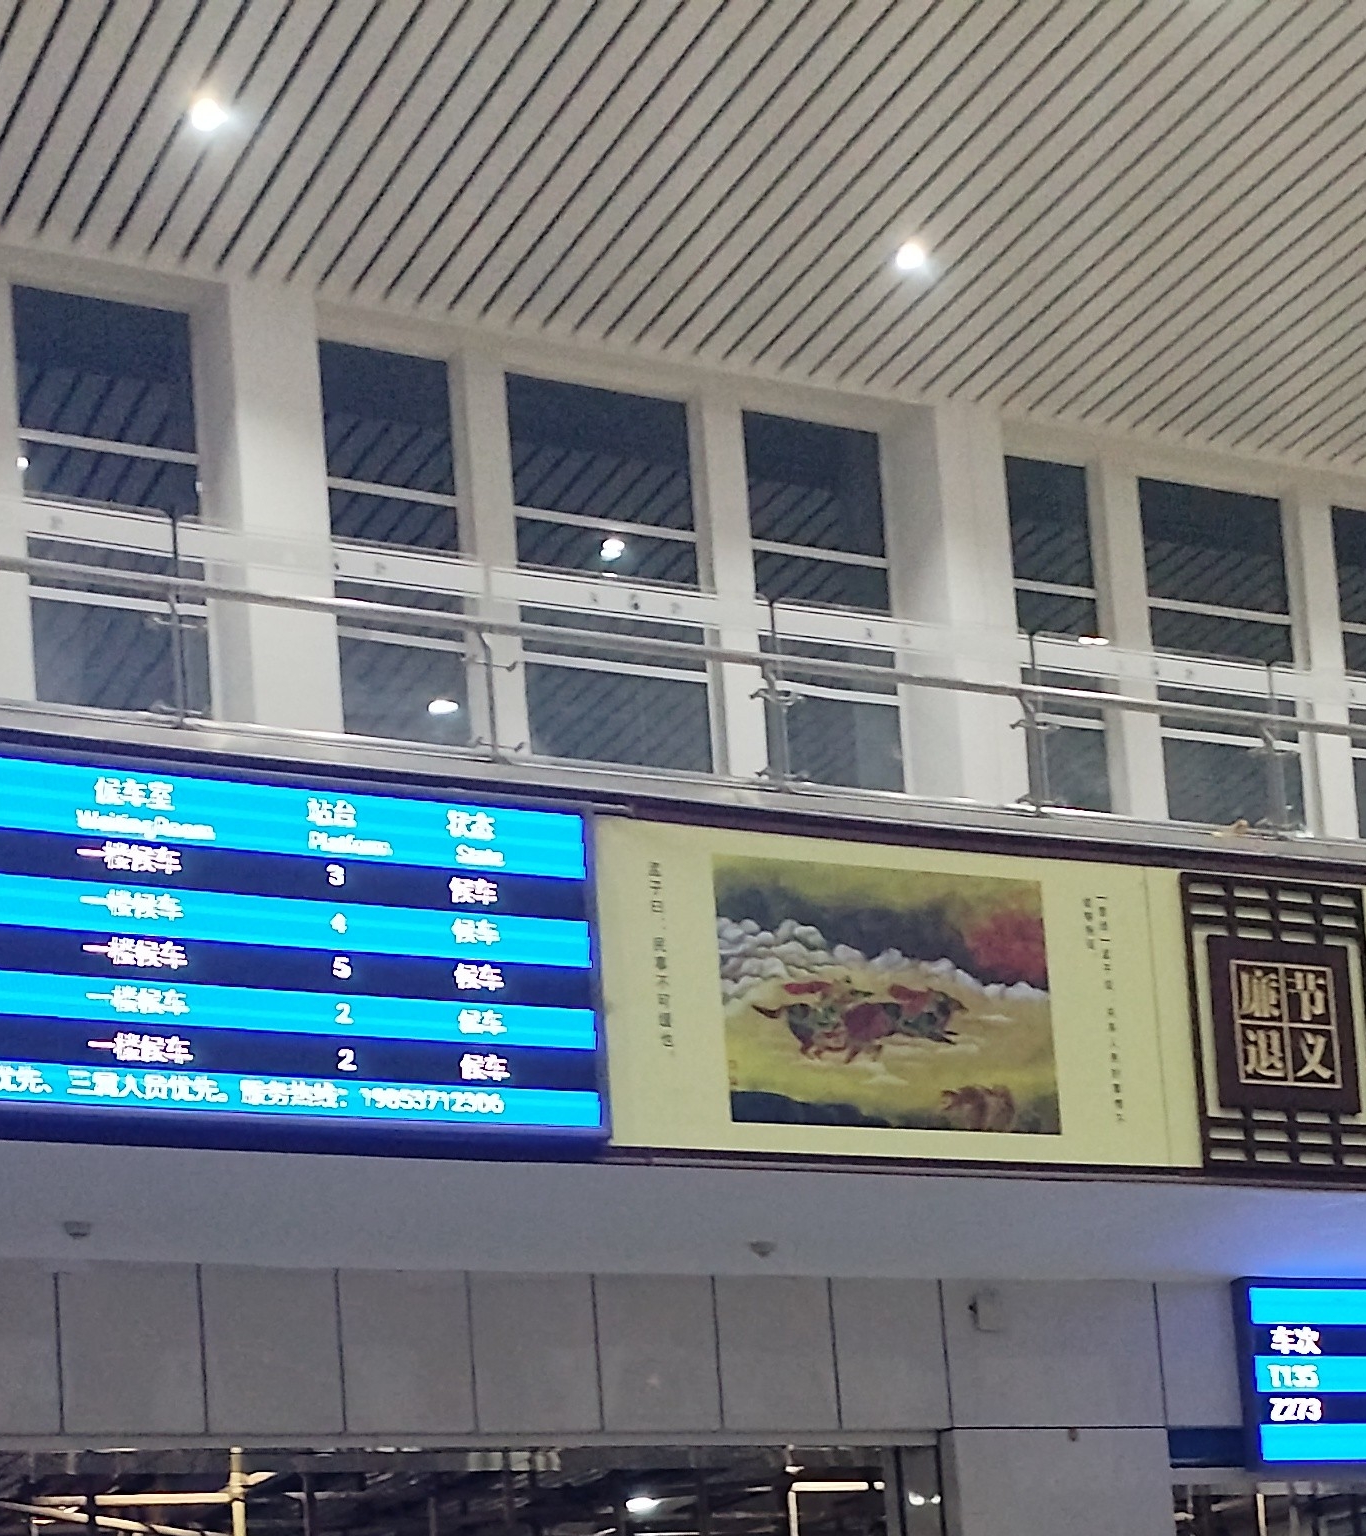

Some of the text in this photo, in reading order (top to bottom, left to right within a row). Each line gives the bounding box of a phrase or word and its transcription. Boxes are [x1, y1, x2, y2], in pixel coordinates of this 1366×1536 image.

[92, 776, 174, 812] 候车室
[307, 797, 357, 828] 站台
[446, 810, 496, 841] 状态
[76, 841, 182, 875] 一楼候车
[326, 864, 345, 887] 3
[448, 876, 498, 906] 候车
[79, 888, 184, 921] 一楼候车
[330, 912, 348, 934] 4
[450, 918, 501, 946] 候车
[82, 937, 188, 970] 一楼候车
[332, 956, 352, 979] 5
[453, 962, 505, 991] 候车
[85, 985, 190, 1016] 一楼候车
[335, 1002, 354, 1025] 2
[458, 1008, 507, 1036] 候车
[87, 1032, 194, 1065] 一楼候车
[337, 1048, 358, 1072] 2
[459, 1053, 511, 1082] 候车
[1269, 1326, 1321, 1354] 车次
